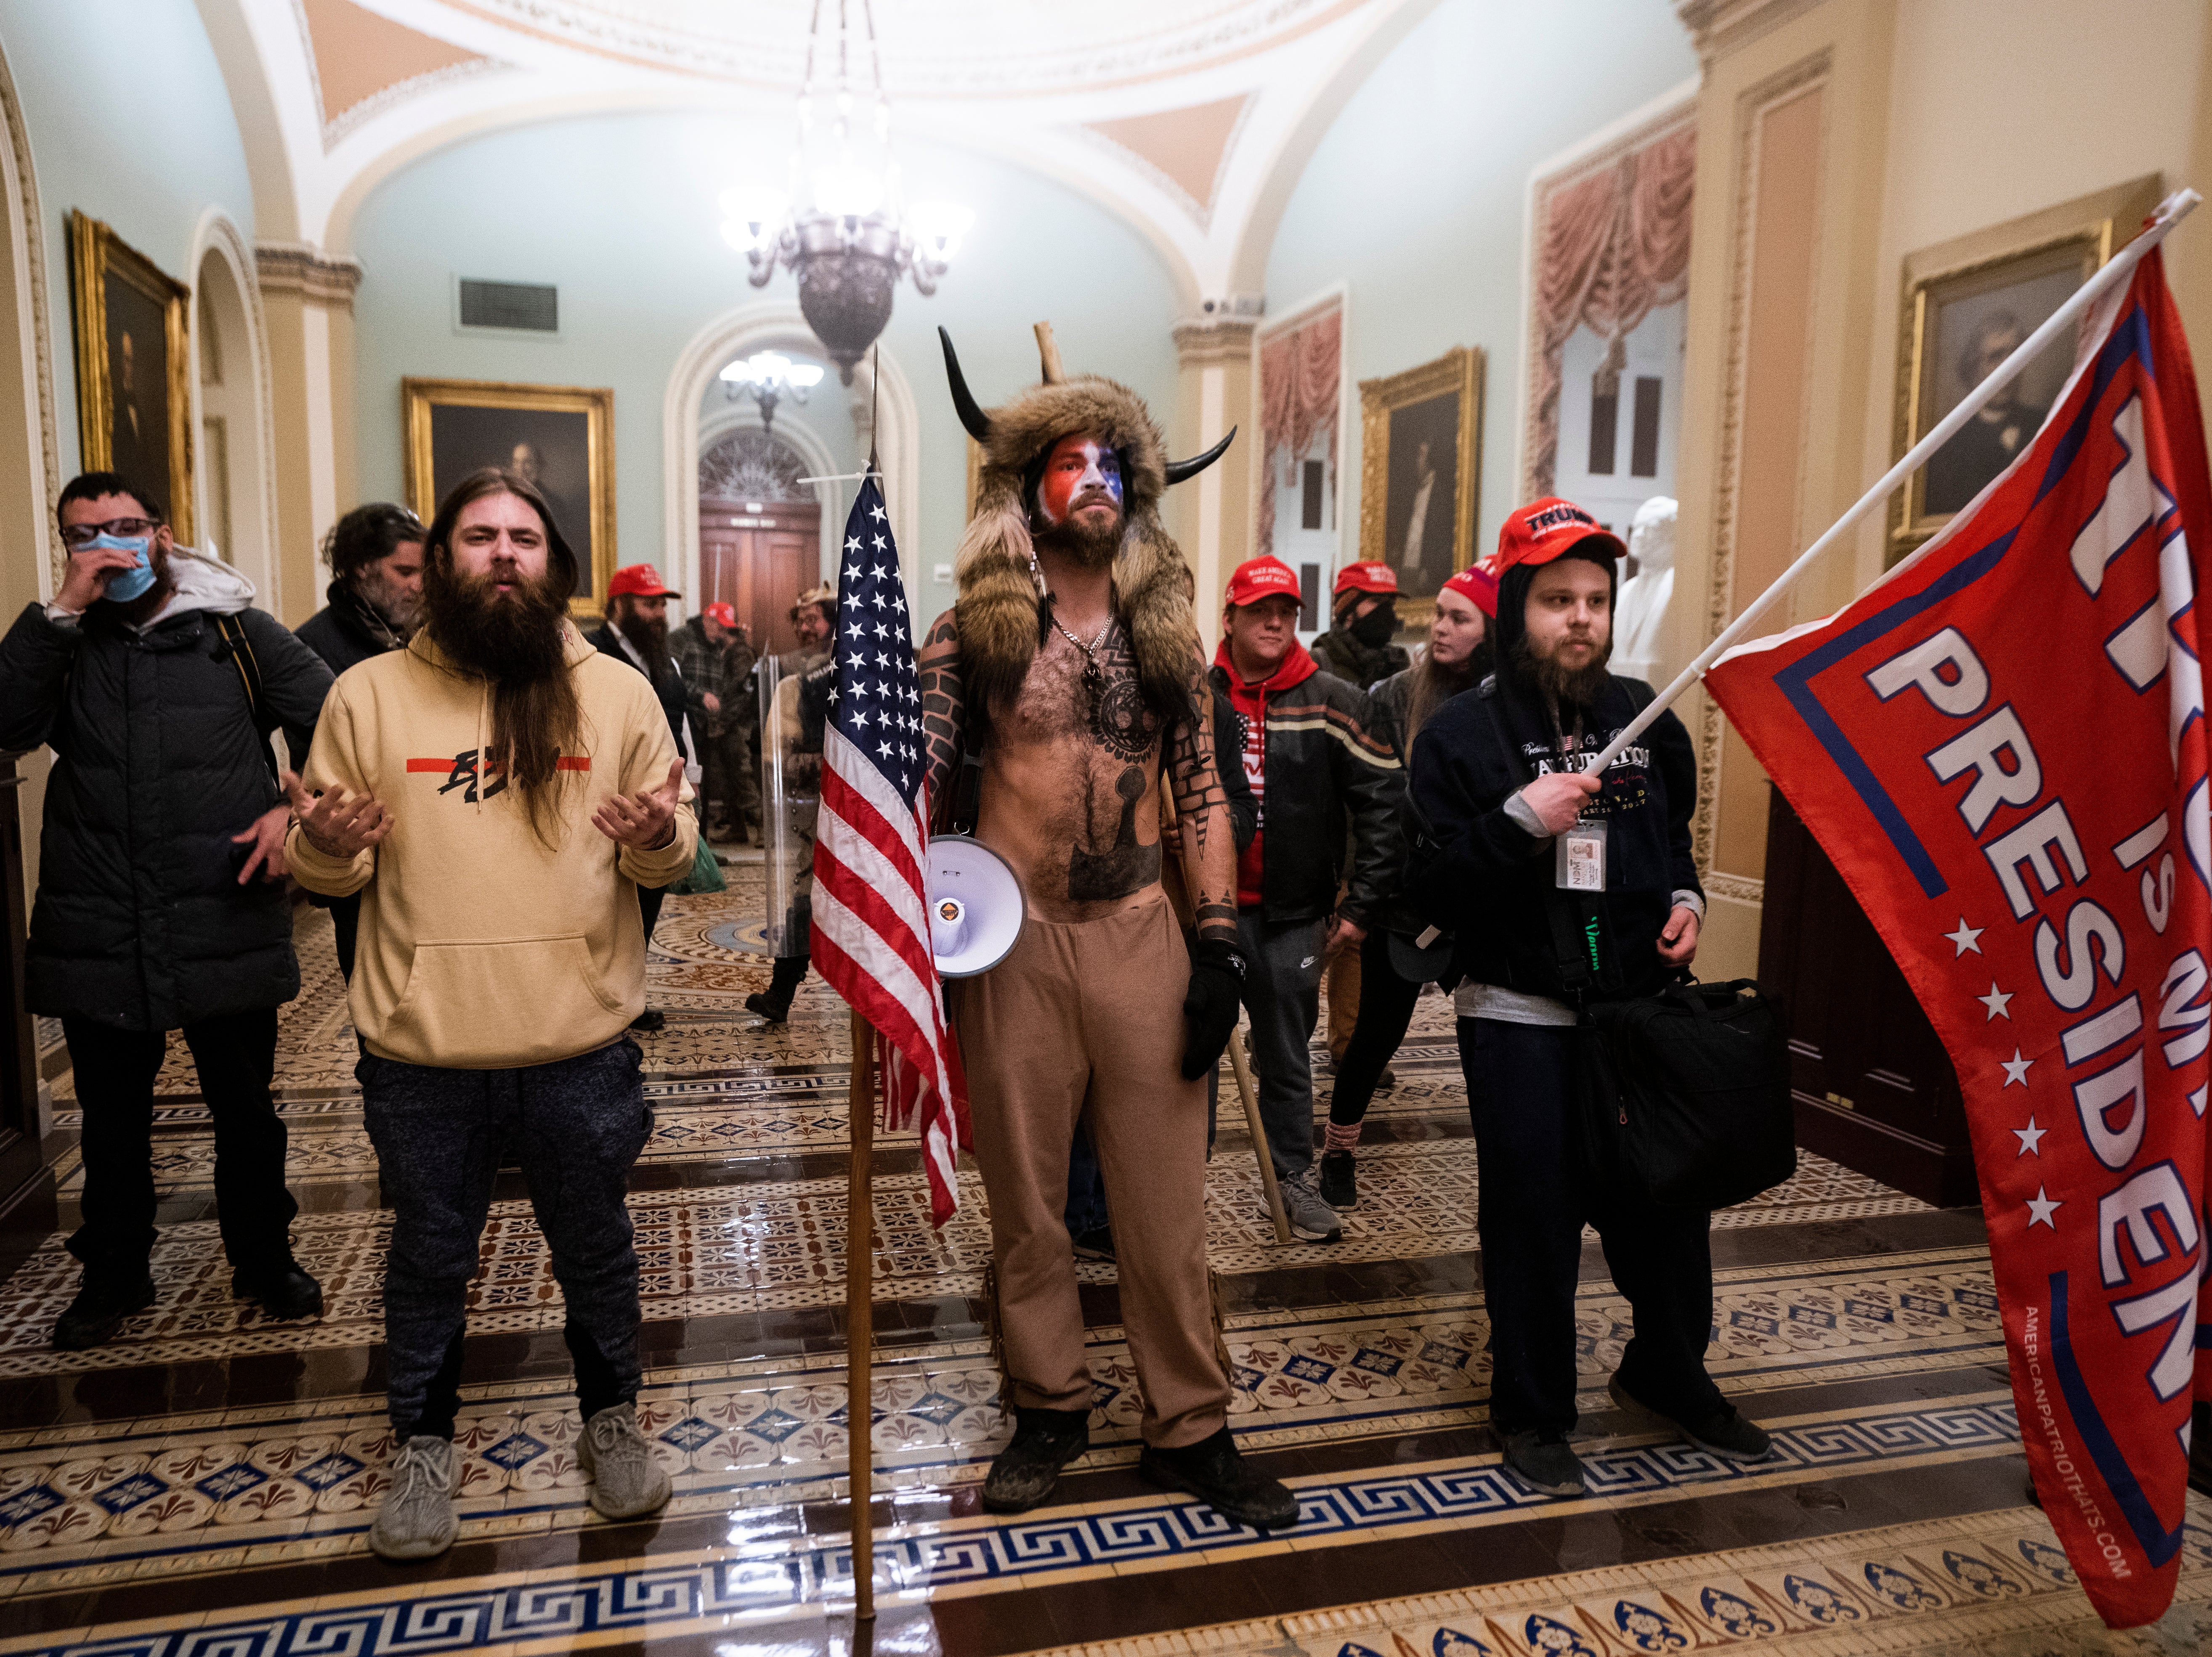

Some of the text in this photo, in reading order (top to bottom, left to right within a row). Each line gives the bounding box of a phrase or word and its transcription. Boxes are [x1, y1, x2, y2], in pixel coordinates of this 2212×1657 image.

[1303, 956, 1314, 964] NIKE
[1861, 624, 2201, 1466] PRESIDEN
[2023, 1305, 2132, 1579] AMERICANPATRIOTHATS.COM
